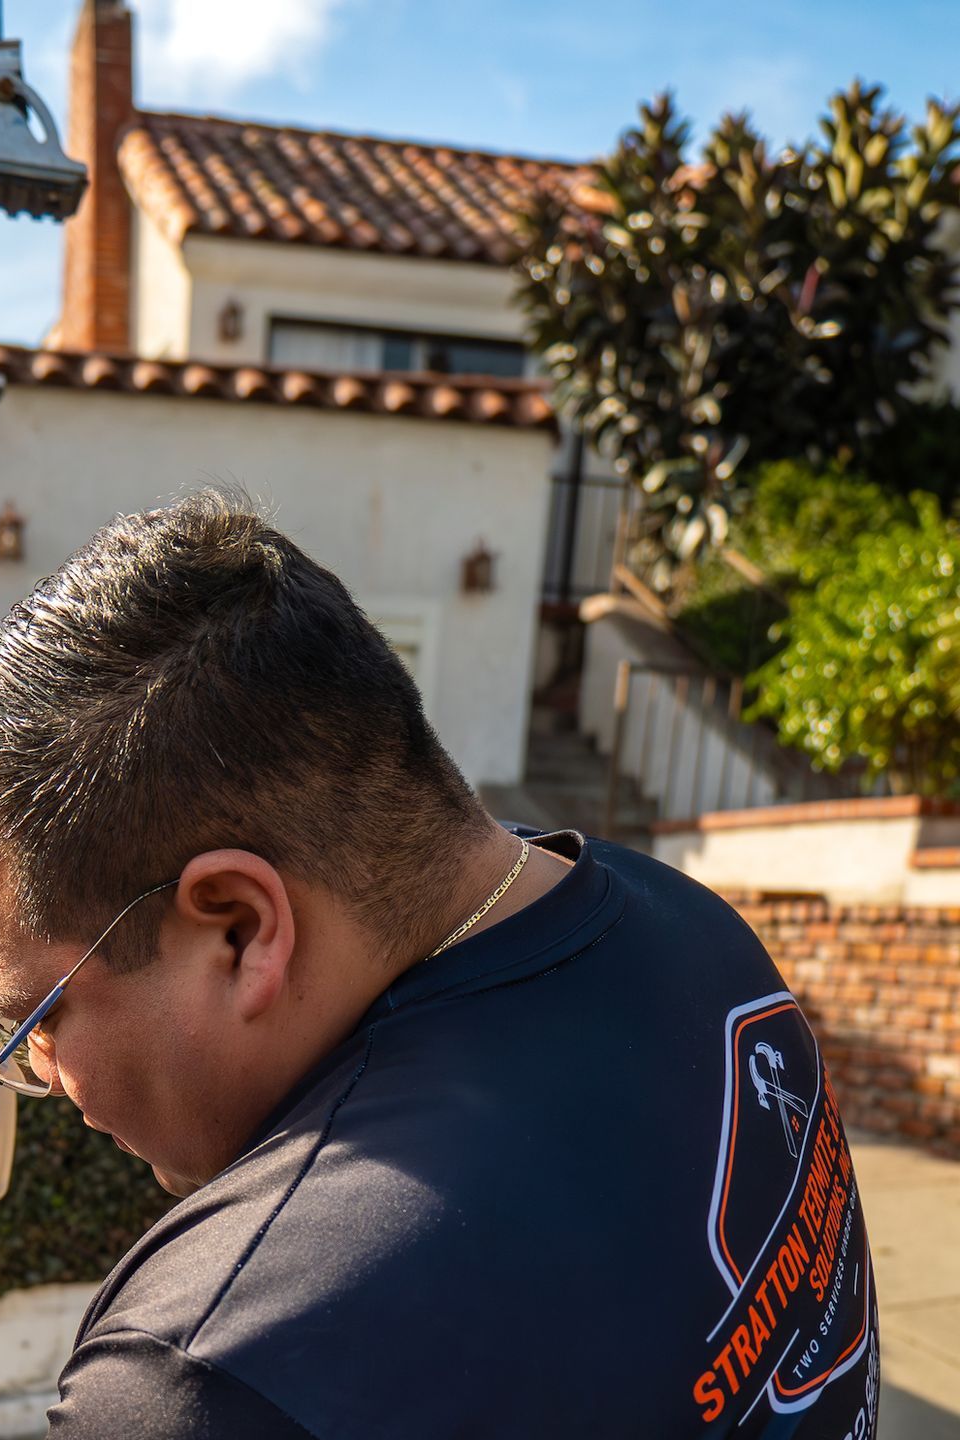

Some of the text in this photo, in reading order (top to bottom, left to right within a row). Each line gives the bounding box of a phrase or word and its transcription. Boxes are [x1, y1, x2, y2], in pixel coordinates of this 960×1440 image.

[692, 1222, 811, 1423] STRATTON
[799, 1117, 838, 1246] TERMITE
[792, 1338, 820, 1380] TWO
[819, 1257, 846, 1336] SERVICES
[840, 1208, 855, 1258] UNDER
